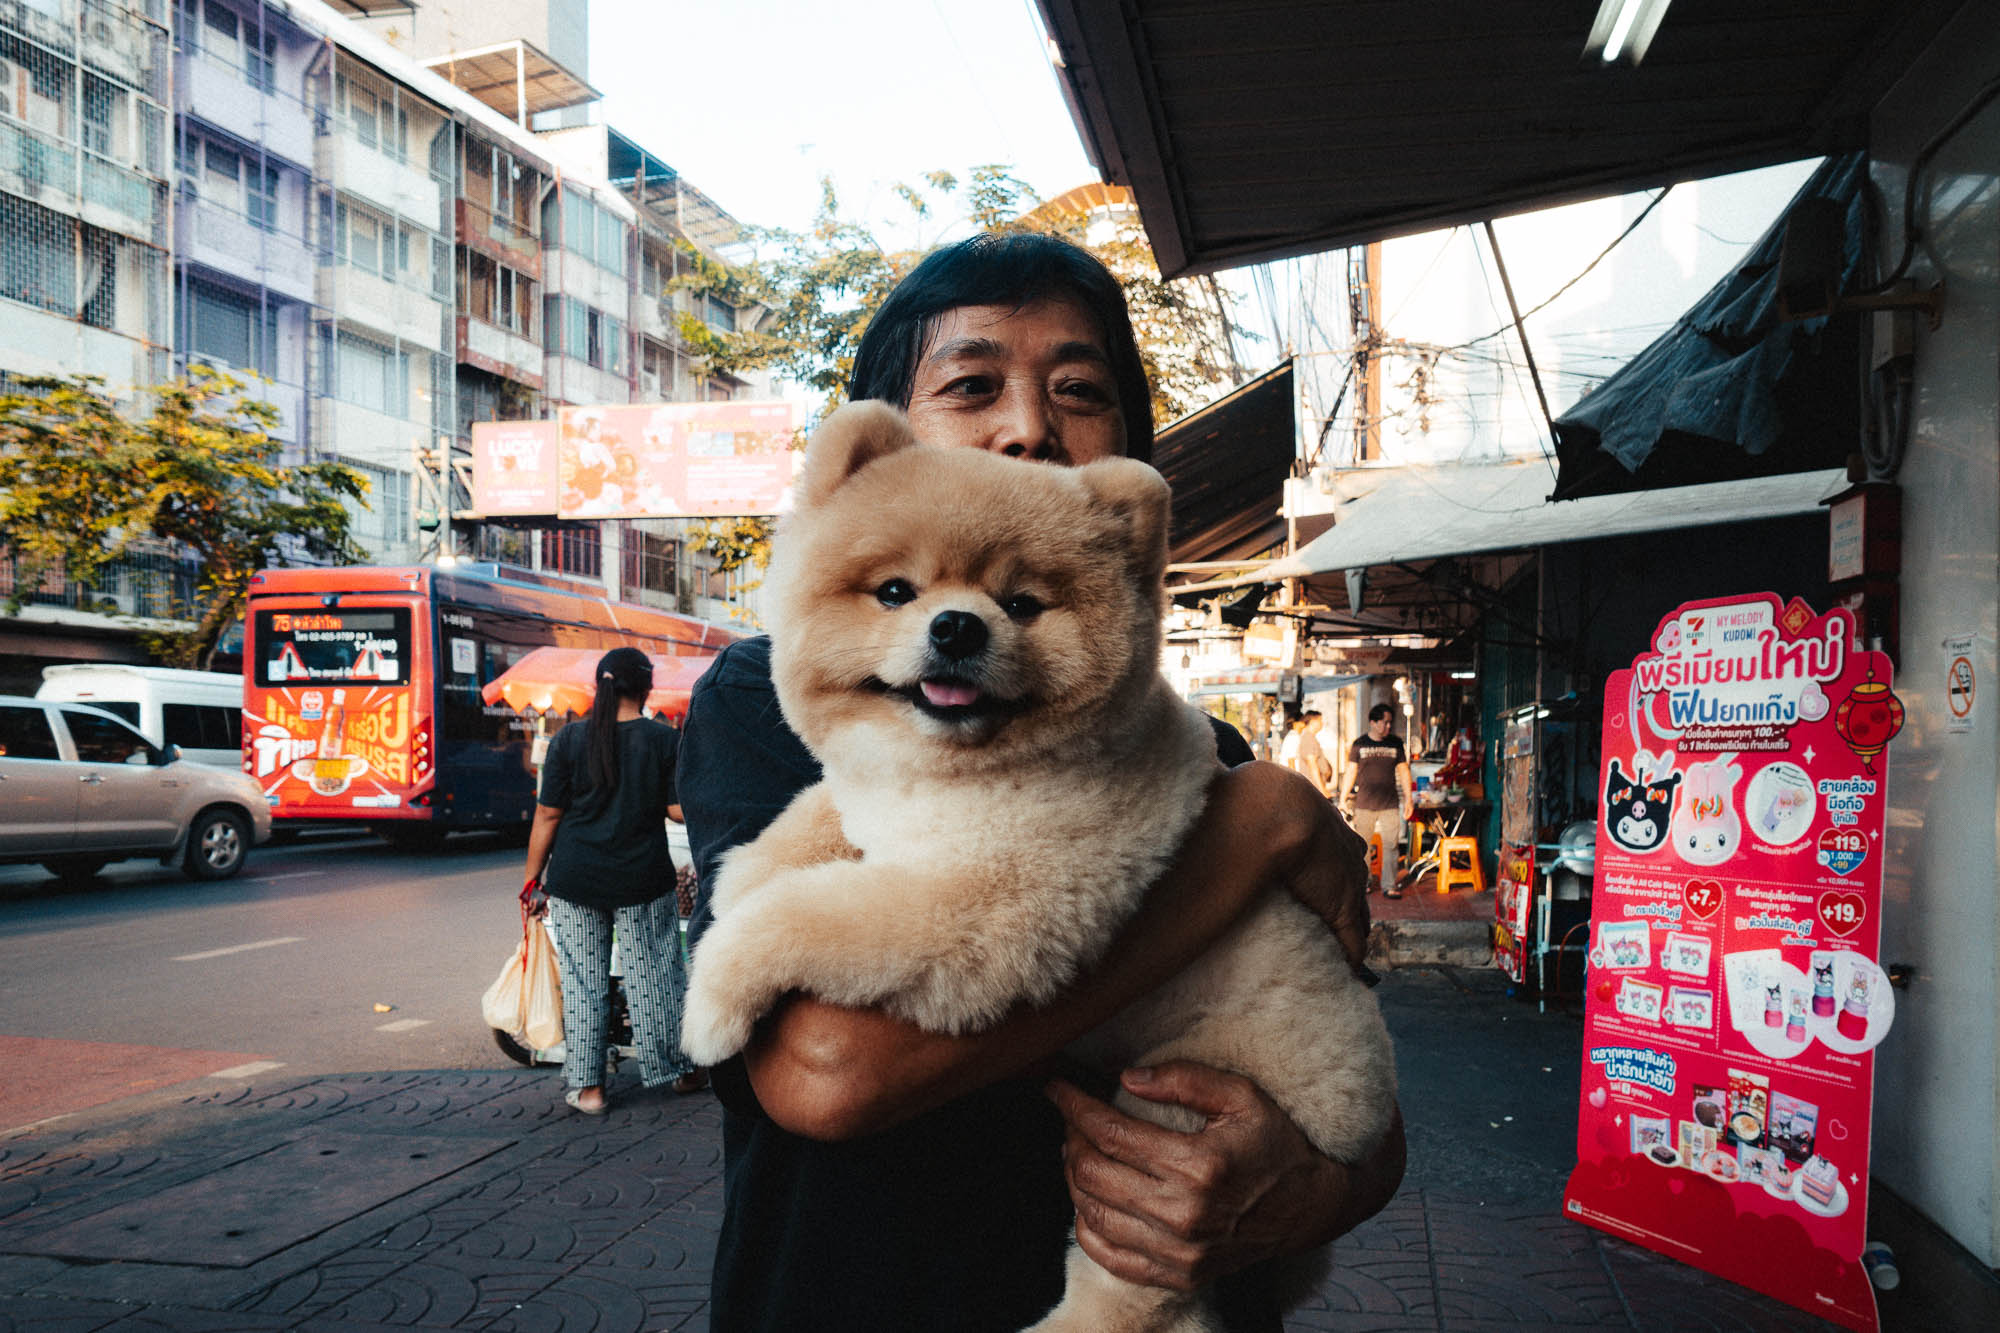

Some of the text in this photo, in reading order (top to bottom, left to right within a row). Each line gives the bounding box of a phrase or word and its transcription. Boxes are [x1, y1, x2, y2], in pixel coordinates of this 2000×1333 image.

[273, 615, 291, 631] 75
[1717, 611, 1764, 628] MY MELODY
[1723, 629, 1756, 642] KUROMI
[1640, 621, 1840, 687] พรีเมียมใหม่
[1672, 689, 1796, 723] ฟินยกแก๊ง
[1820, 776, 1875, 793] สายคล้อง
[1829, 796, 1863, 810] มือถือ
[1592, 1049, 1674, 1072] หลากหลายสินค้า
